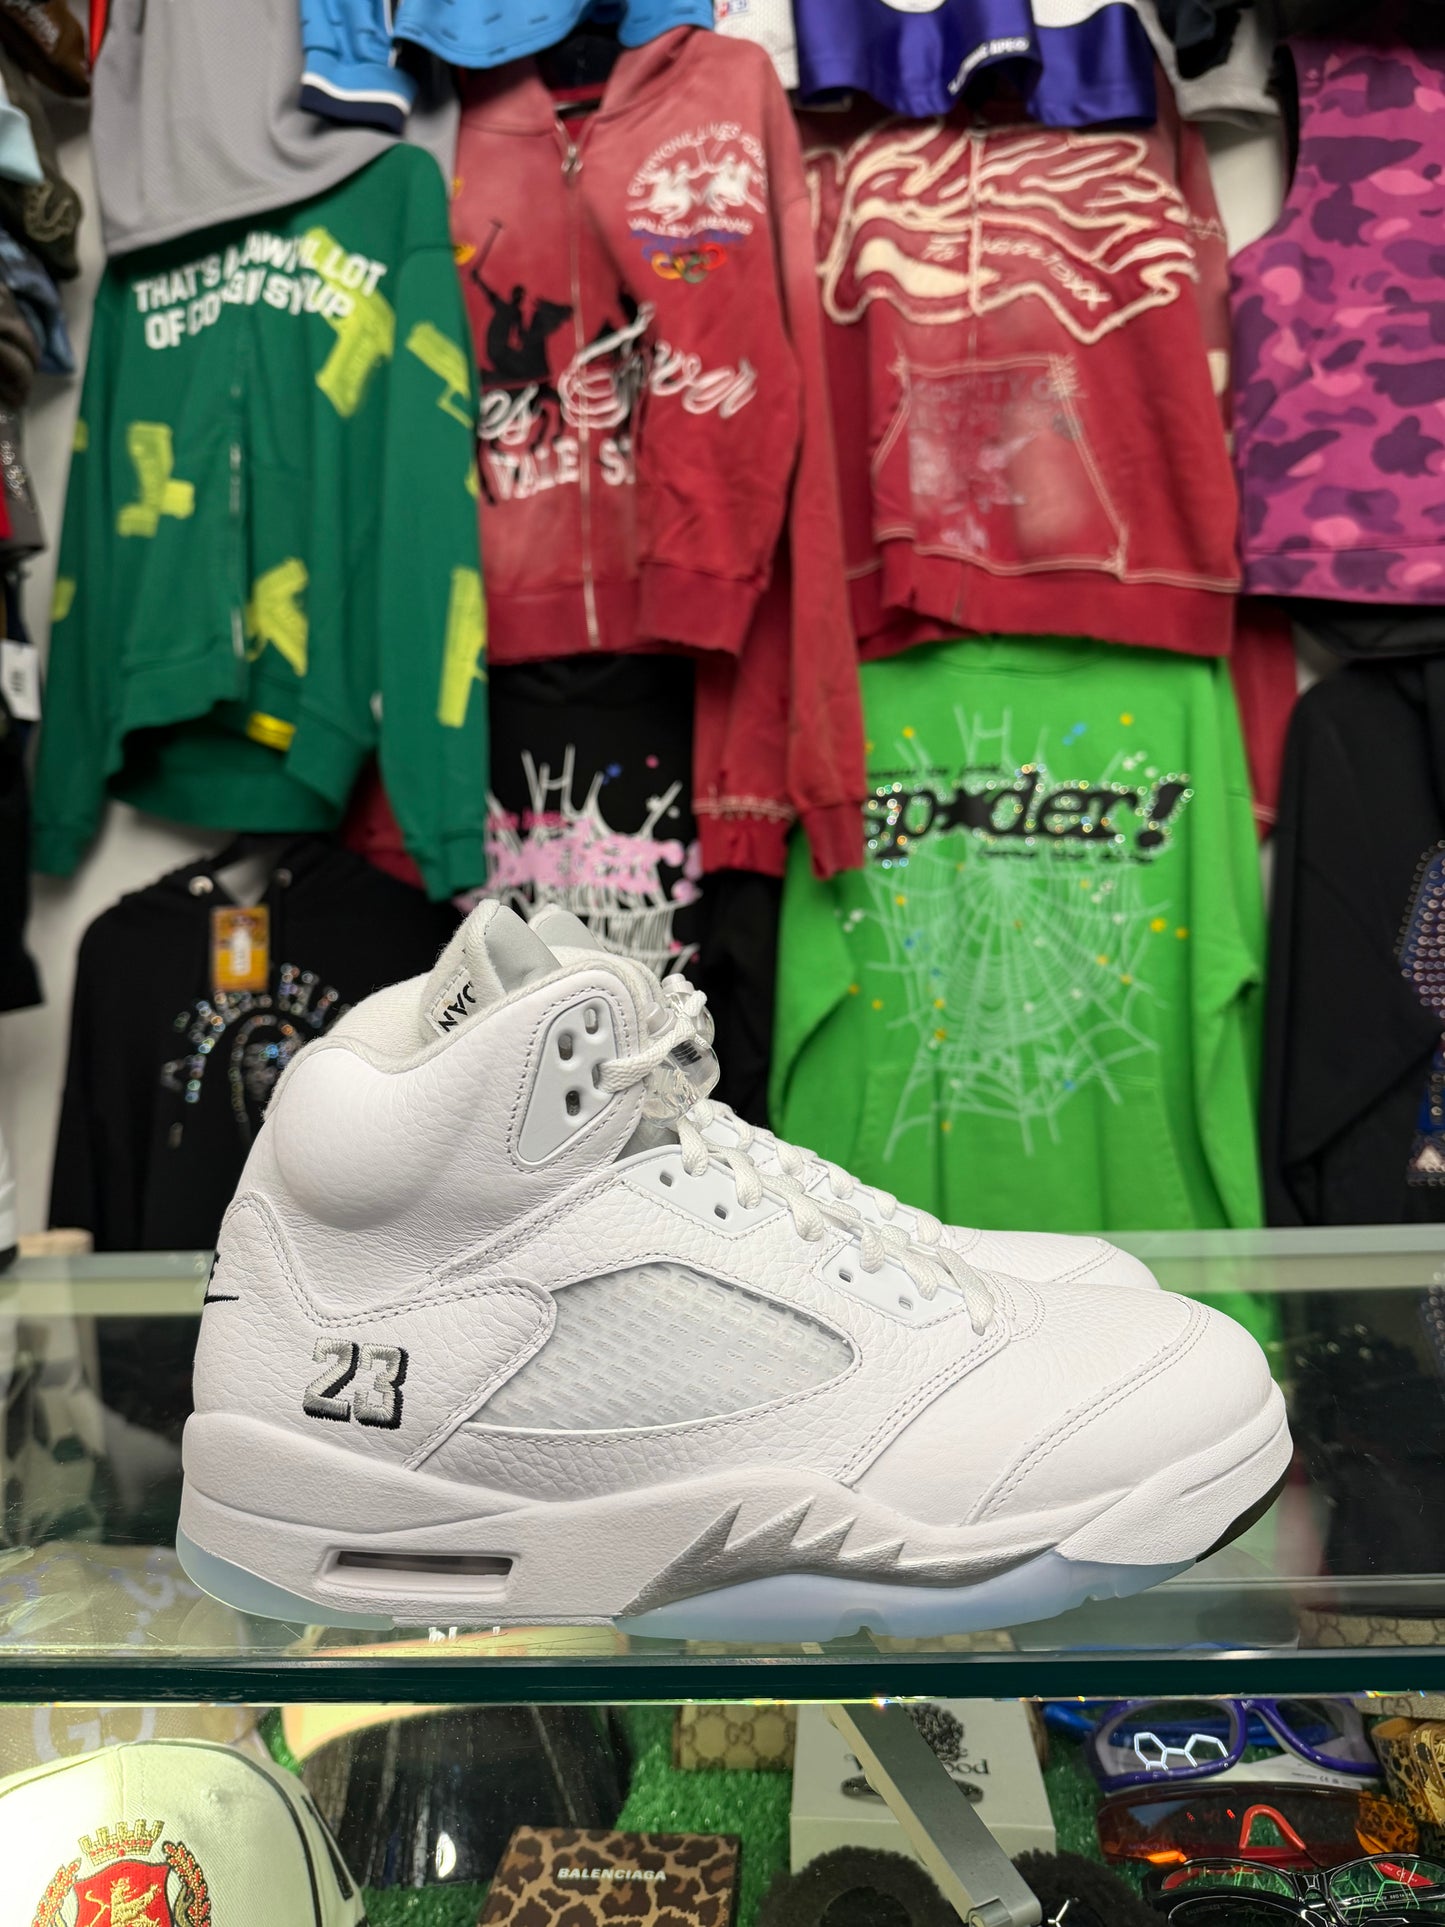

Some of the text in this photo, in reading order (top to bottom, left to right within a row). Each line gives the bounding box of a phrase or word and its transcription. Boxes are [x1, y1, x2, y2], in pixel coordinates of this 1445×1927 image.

[133, 253, 221, 313] THAT'S
[145, 307, 187, 350] OF
[302, 1336, 409, 1430] 23
[557, 1867, 667, 1881] BALENCIAGA
